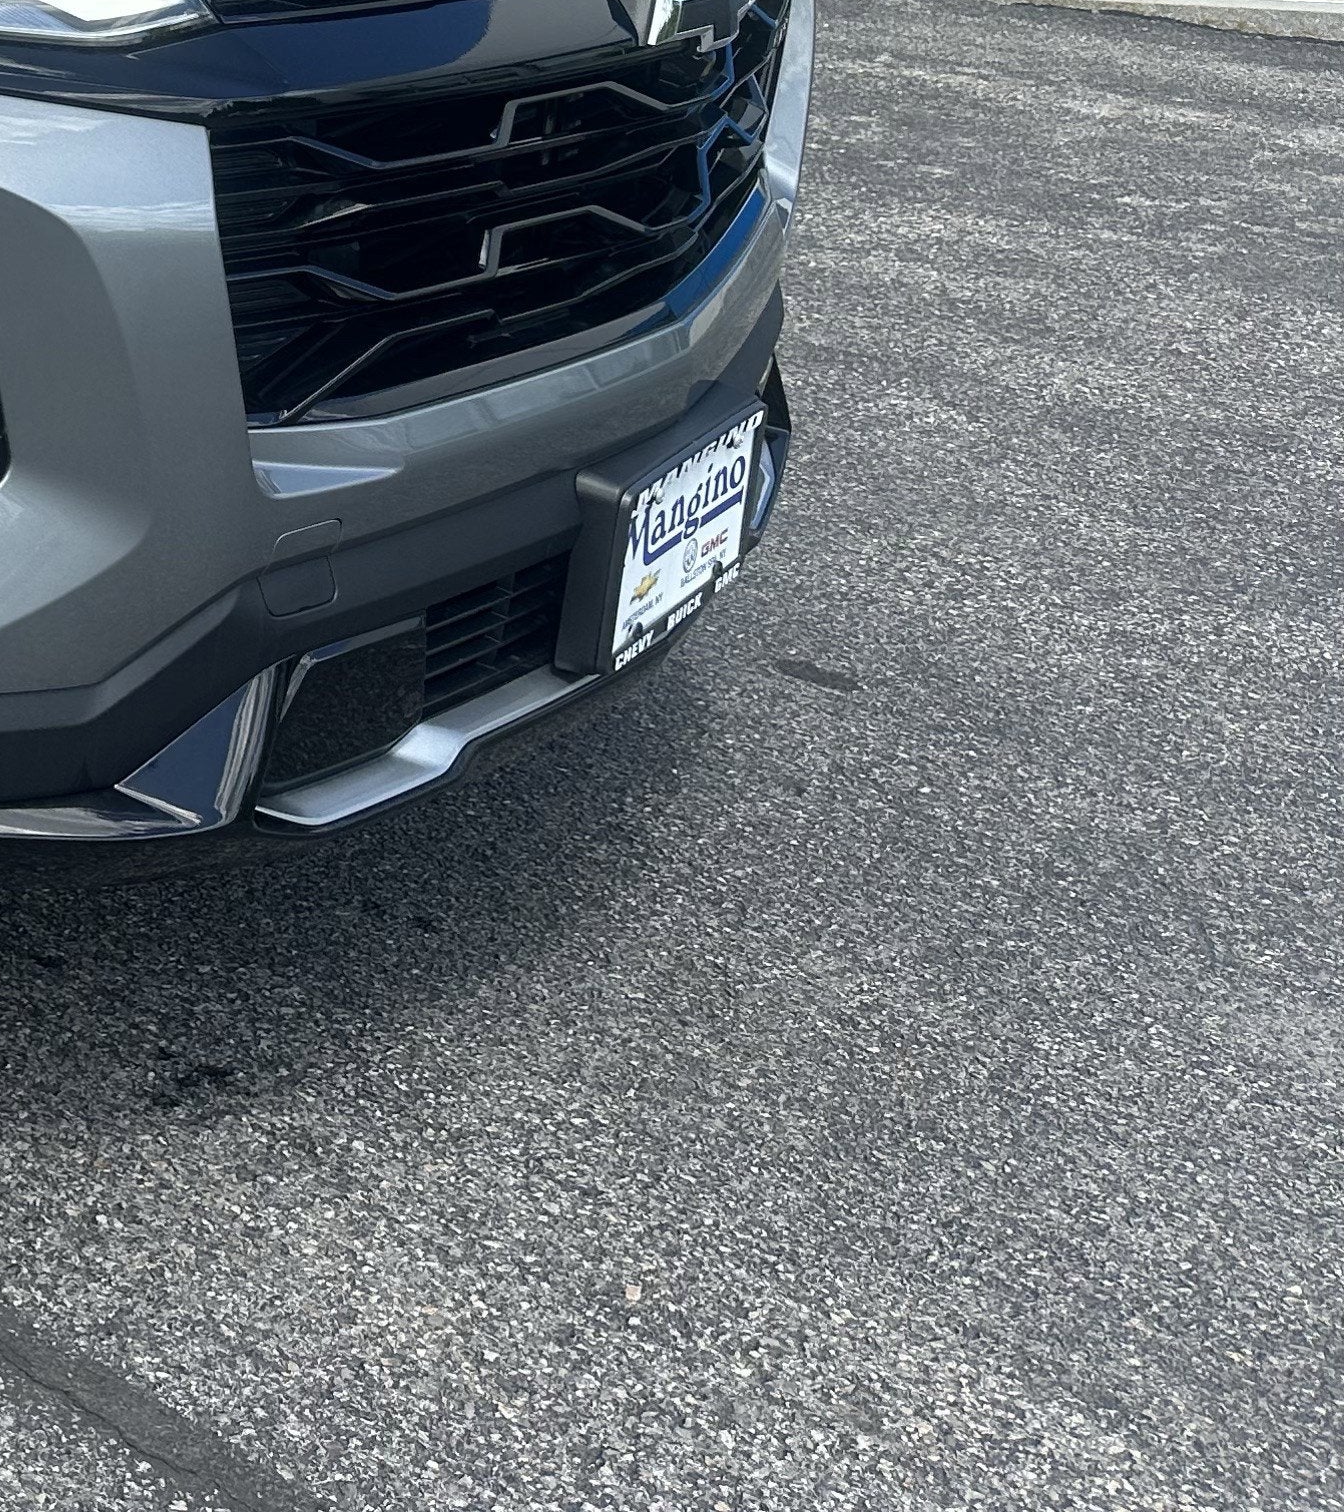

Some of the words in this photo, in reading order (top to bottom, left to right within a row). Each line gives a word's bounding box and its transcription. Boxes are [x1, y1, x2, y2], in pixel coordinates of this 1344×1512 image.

[629, 455, 746, 566] Mangino
[701, 528, 729, 558] GMC
[615, 630, 654, 671] CHEVY
[667, 592, 703, 631] BUICK
[714, 562, 741, 593] GMC
